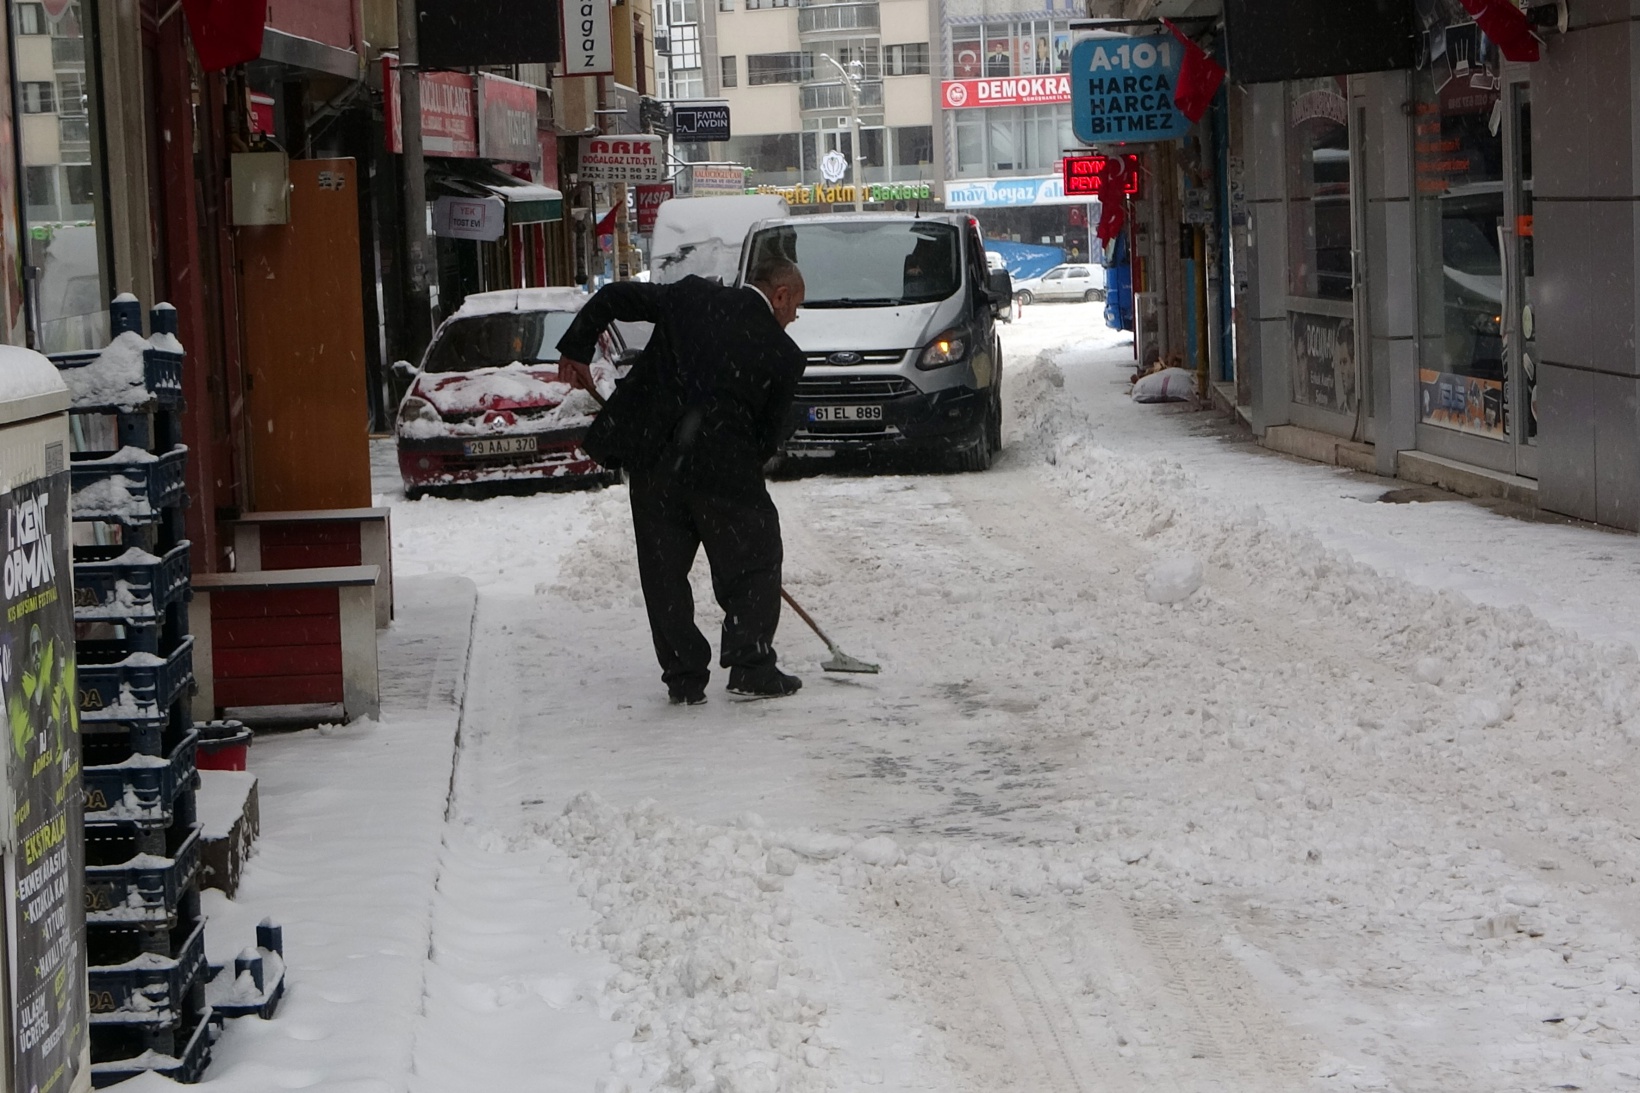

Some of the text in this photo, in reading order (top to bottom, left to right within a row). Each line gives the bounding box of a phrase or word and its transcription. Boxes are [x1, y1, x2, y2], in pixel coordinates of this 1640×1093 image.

[1090, 74, 1170, 95] HARCA
[1091, 93, 1171, 115] HARCA
[697, 111, 728, 119] FATMA
[582, 154, 624, 165] DOĞALGAZ
[987, 184, 1035, 204] beyaz
[453, 218, 468, 227] TOST
[815, 407, 881, 419] 61 EL 889
[471, 438, 536, 454] 29 AAJ 370
[4, 533, 56, 600] ORMAN
